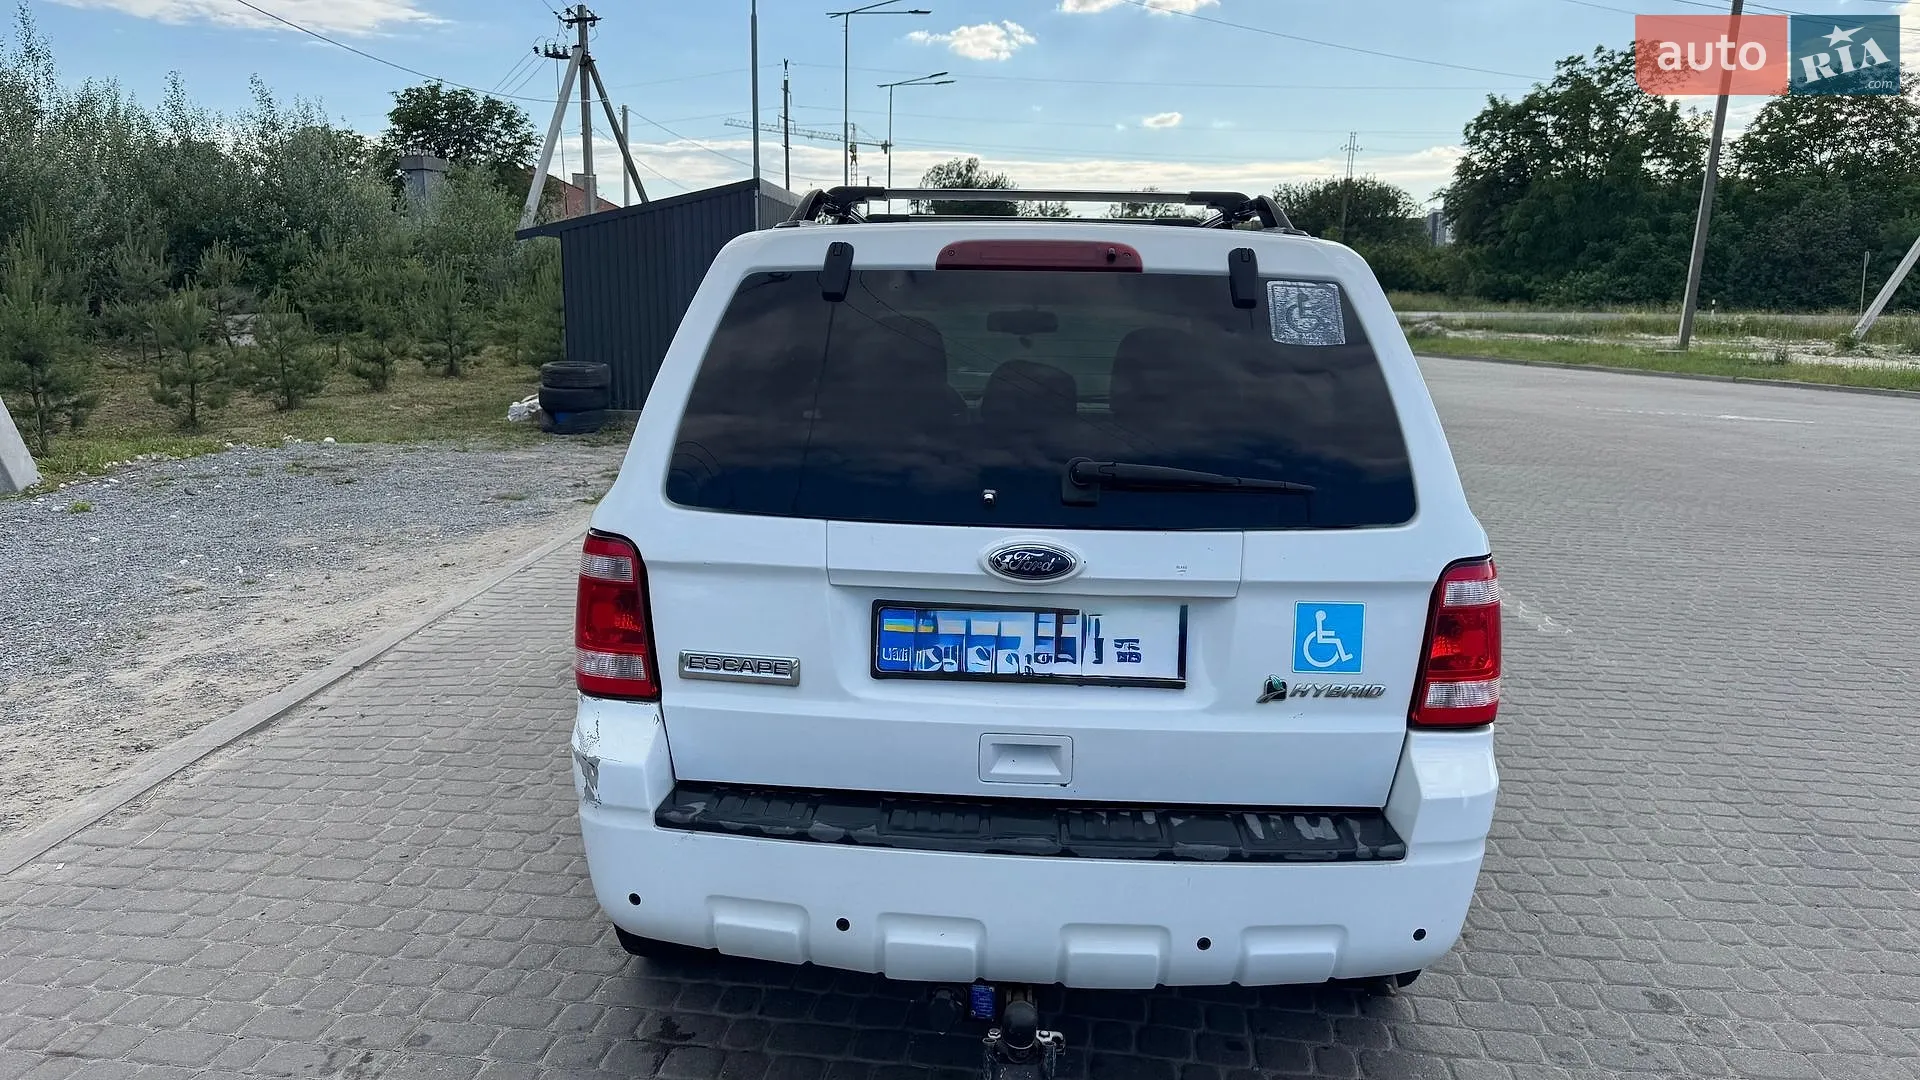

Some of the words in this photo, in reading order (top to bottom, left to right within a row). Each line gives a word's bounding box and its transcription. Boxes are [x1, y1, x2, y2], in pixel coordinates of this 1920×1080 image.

[1008, 551, 1056, 572] Ford
[687, 655, 790, 676] ESCAPE
[1289, 683, 1387, 698] HYBRID
